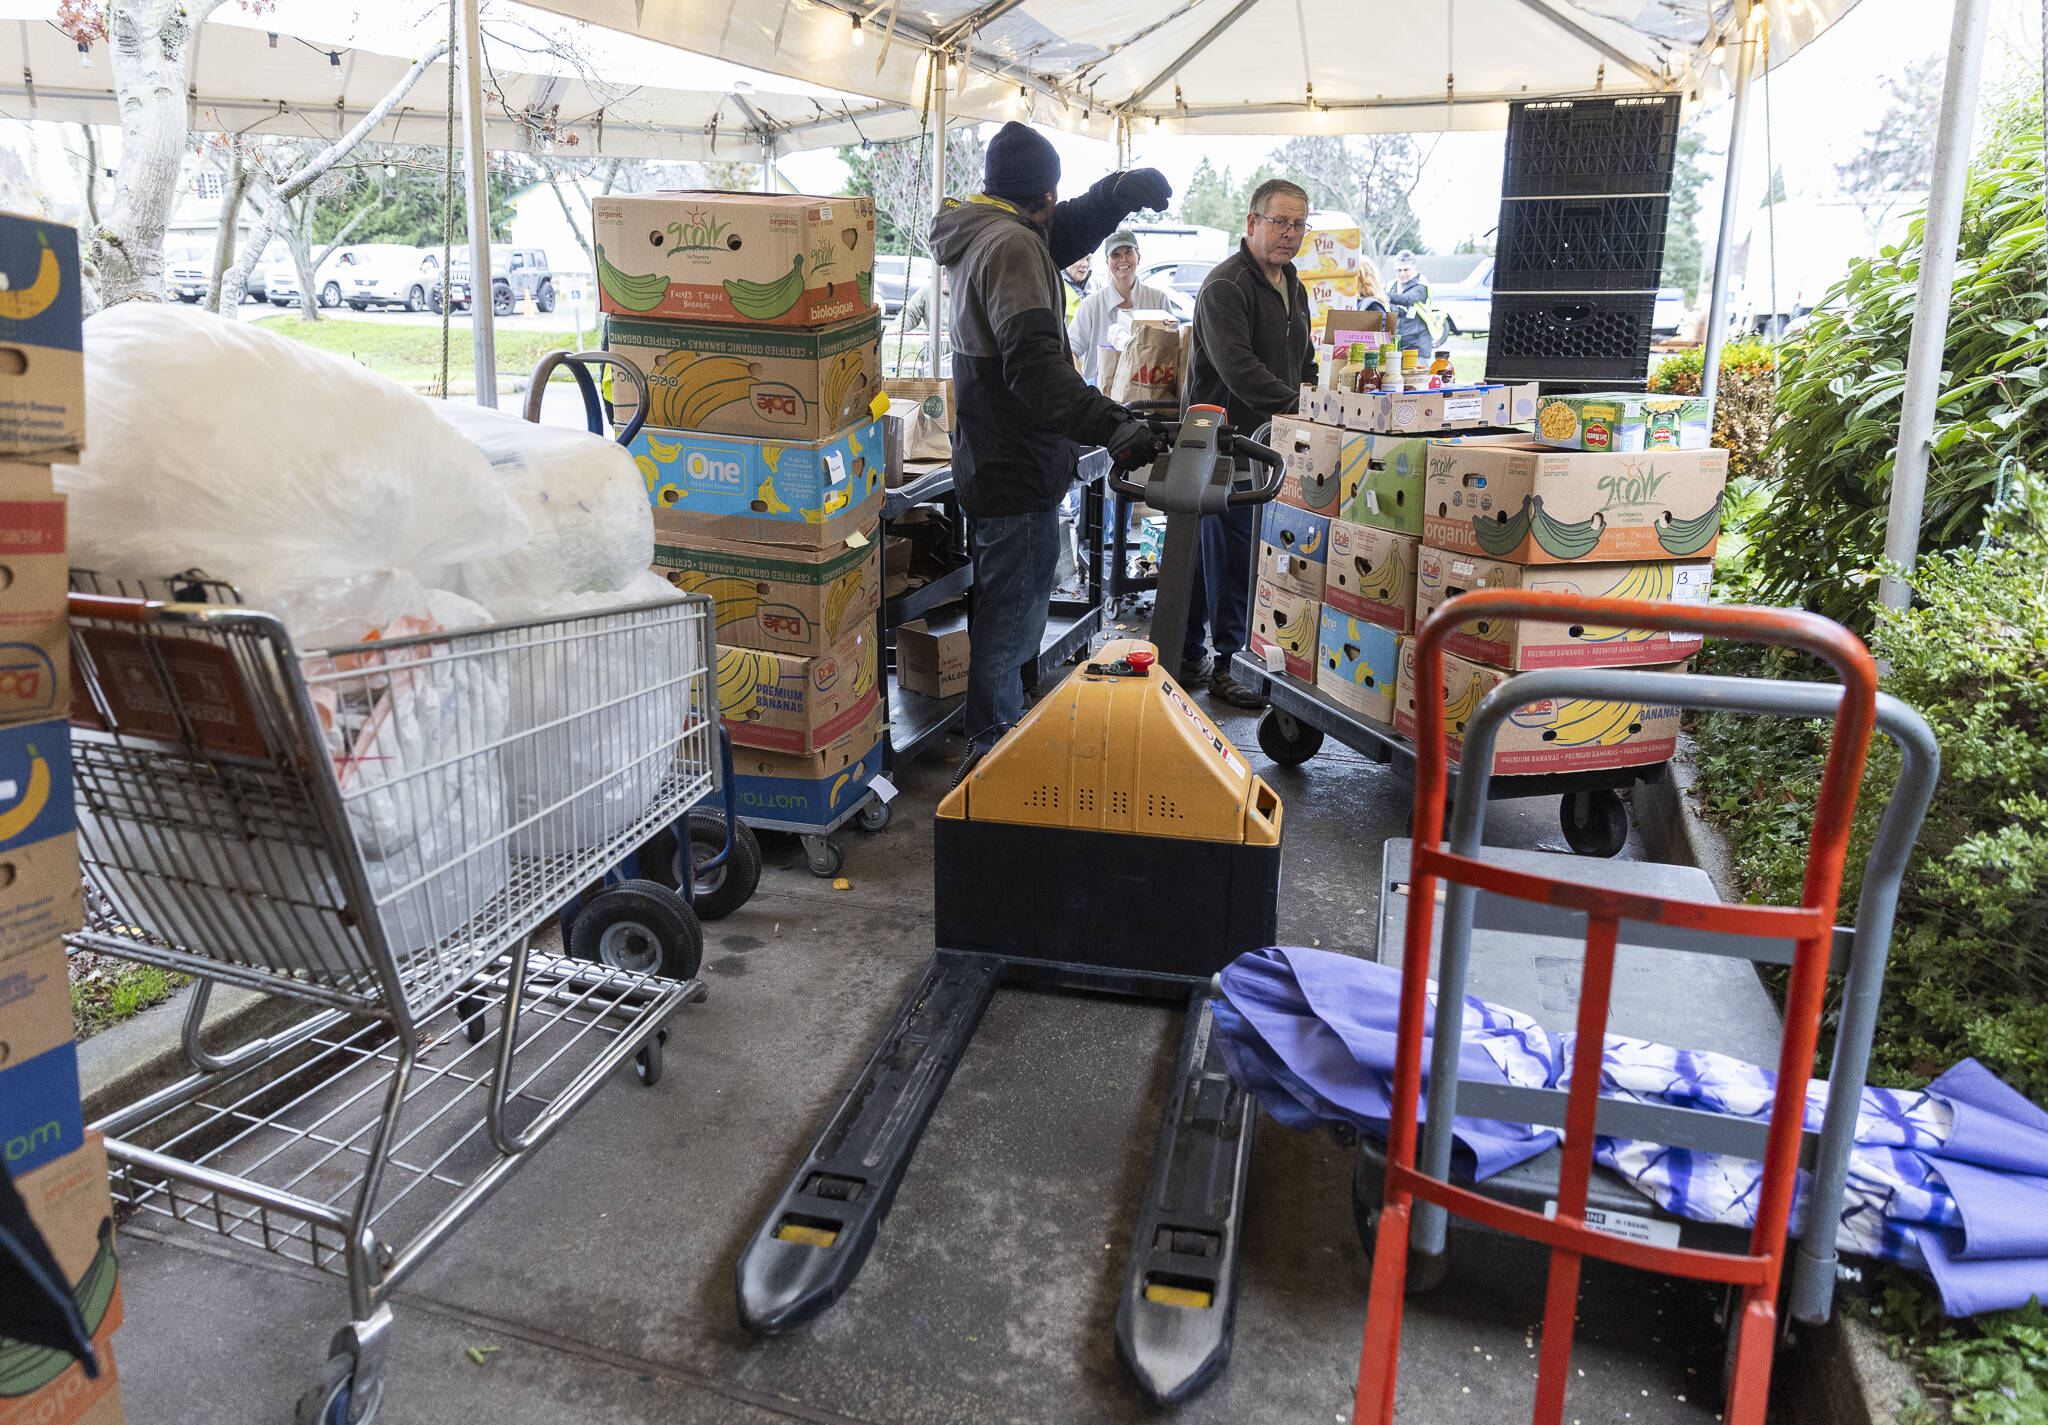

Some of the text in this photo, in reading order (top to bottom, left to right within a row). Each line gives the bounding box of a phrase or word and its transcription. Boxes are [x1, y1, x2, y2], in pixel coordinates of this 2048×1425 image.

[667, 213, 731, 247] grow
[769, 218, 798, 226] organic
[1314, 238, 1333, 253] Pia
[1313, 287, 1332, 300] Pia
[811, 300, 854, 321] biologique
[610, 332, 642, 344] ORGANIC
[643, 335, 681, 347] CERTIFIED
[687, 340, 726, 351] BANANAS
[728, 343, 763, 354] ORGANIC
[765, 347, 805, 357] CERTIFIED
[1131, 362, 1174, 385] ACE
[757, 397, 796, 415] Dole
[687, 451, 740, 483] One
[1543, 463, 1569, 471] organic
[1597, 462, 1672, 505] grow
[1335, 530, 1350, 546] Dole
[1425, 521, 1477, 546] organic
[656, 555, 810, 582] CERTIFIED ORGANIC BANANAS CERTIFIED
[1423, 559, 1440, 577] Dole
[1676, 571, 1688, 585] 13
[1260, 584, 1272, 599] Dole
[763, 617, 800, 635] Dole
[1322, 613, 1337, 632] One
[1527, 649, 1556, 658] PREMIUM
[1556, 648, 1585, 657] BANANAS
[1592, 646, 1618, 655] PREMIUM
[1618, 644, 1644, 654] BANANAS
[817, 662, 835, 682] Dole
[756, 683, 803, 701] PREMIUM
[756, 695, 804, 713] BANANAS
[1640, 706, 1680, 722] BANANAS
[1501, 754, 1531, 763] PREMIUM
[1531, 753, 1560, 762] BANANAS
[1564, 751, 1591, 760] PREMIUM
[1592, 749, 1619, 758] BANANAS
[1623, 745, 1649, 754] PREMIUM
[1649, 742, 1673, 752] BANANAS
[1595, 1225, 1650, 1241] PLATFORM TRUCK
